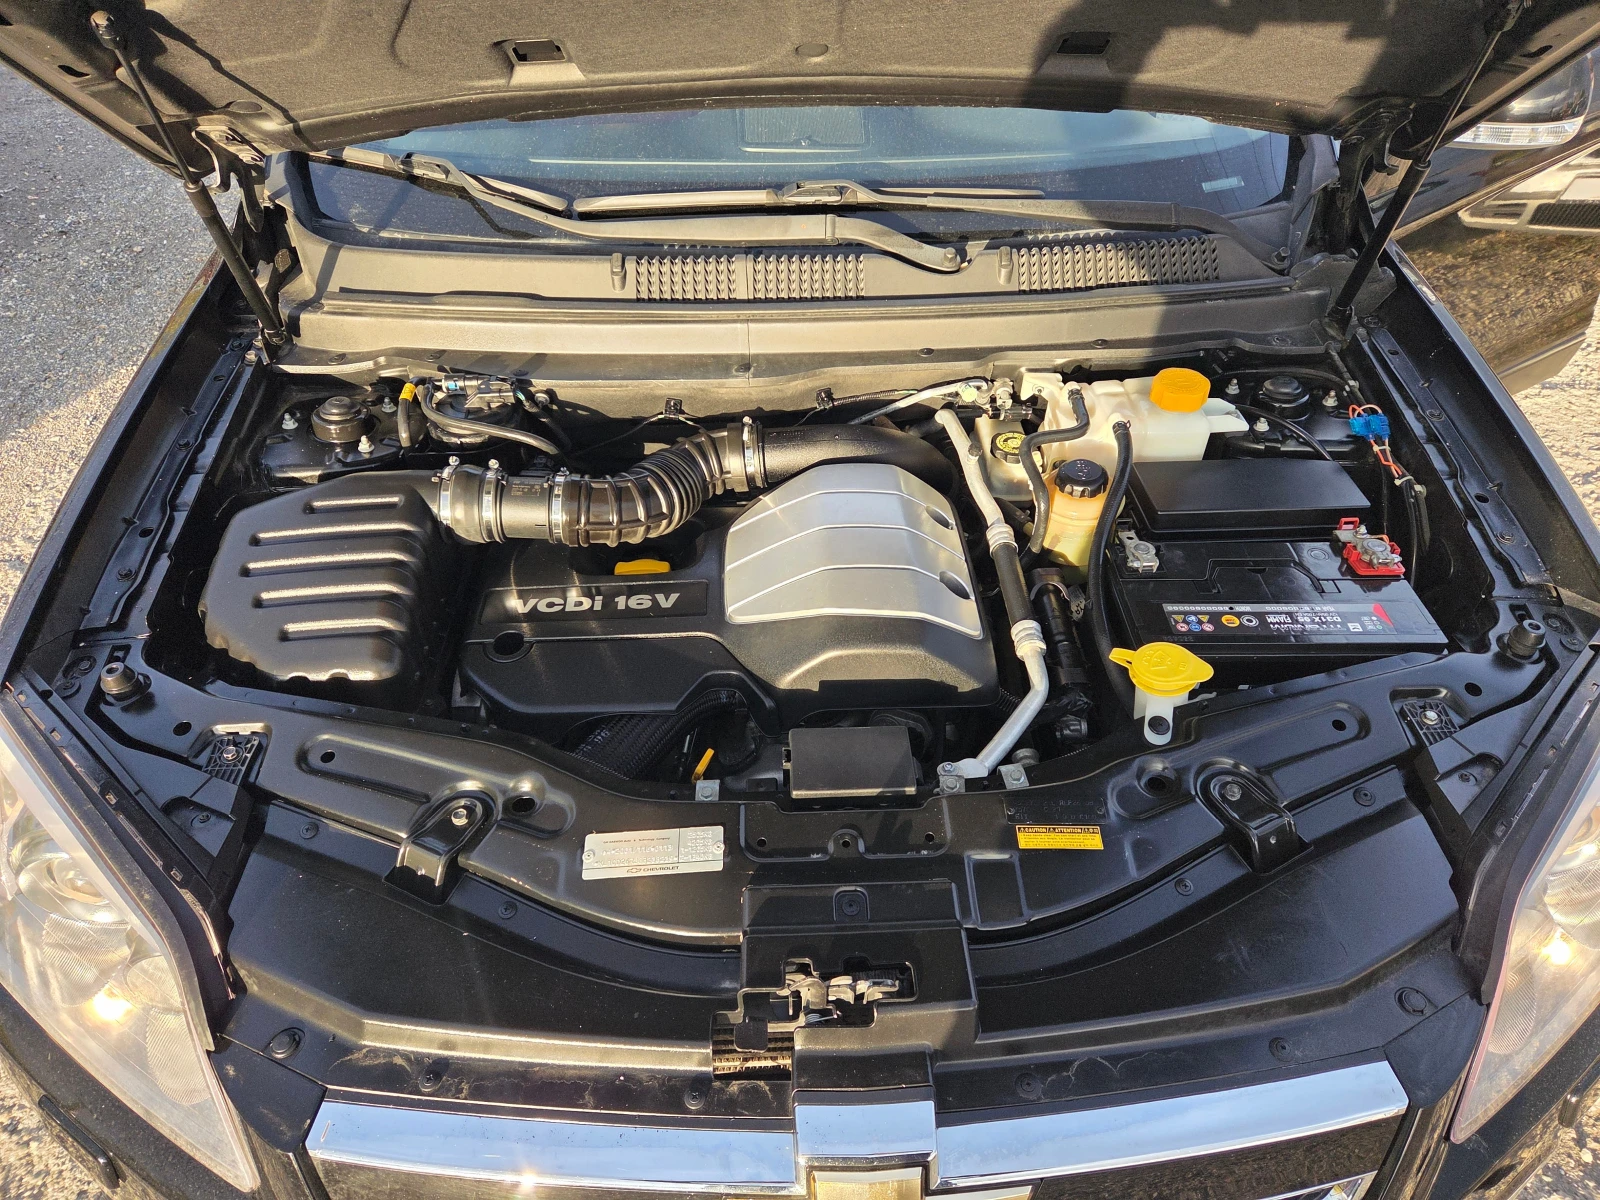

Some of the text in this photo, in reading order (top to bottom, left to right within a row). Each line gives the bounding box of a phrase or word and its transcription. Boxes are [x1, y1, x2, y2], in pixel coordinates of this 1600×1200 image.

[515, 592, 681, 614] VCDi 16V
[1266, 615, 1292, 623] FIAMM
